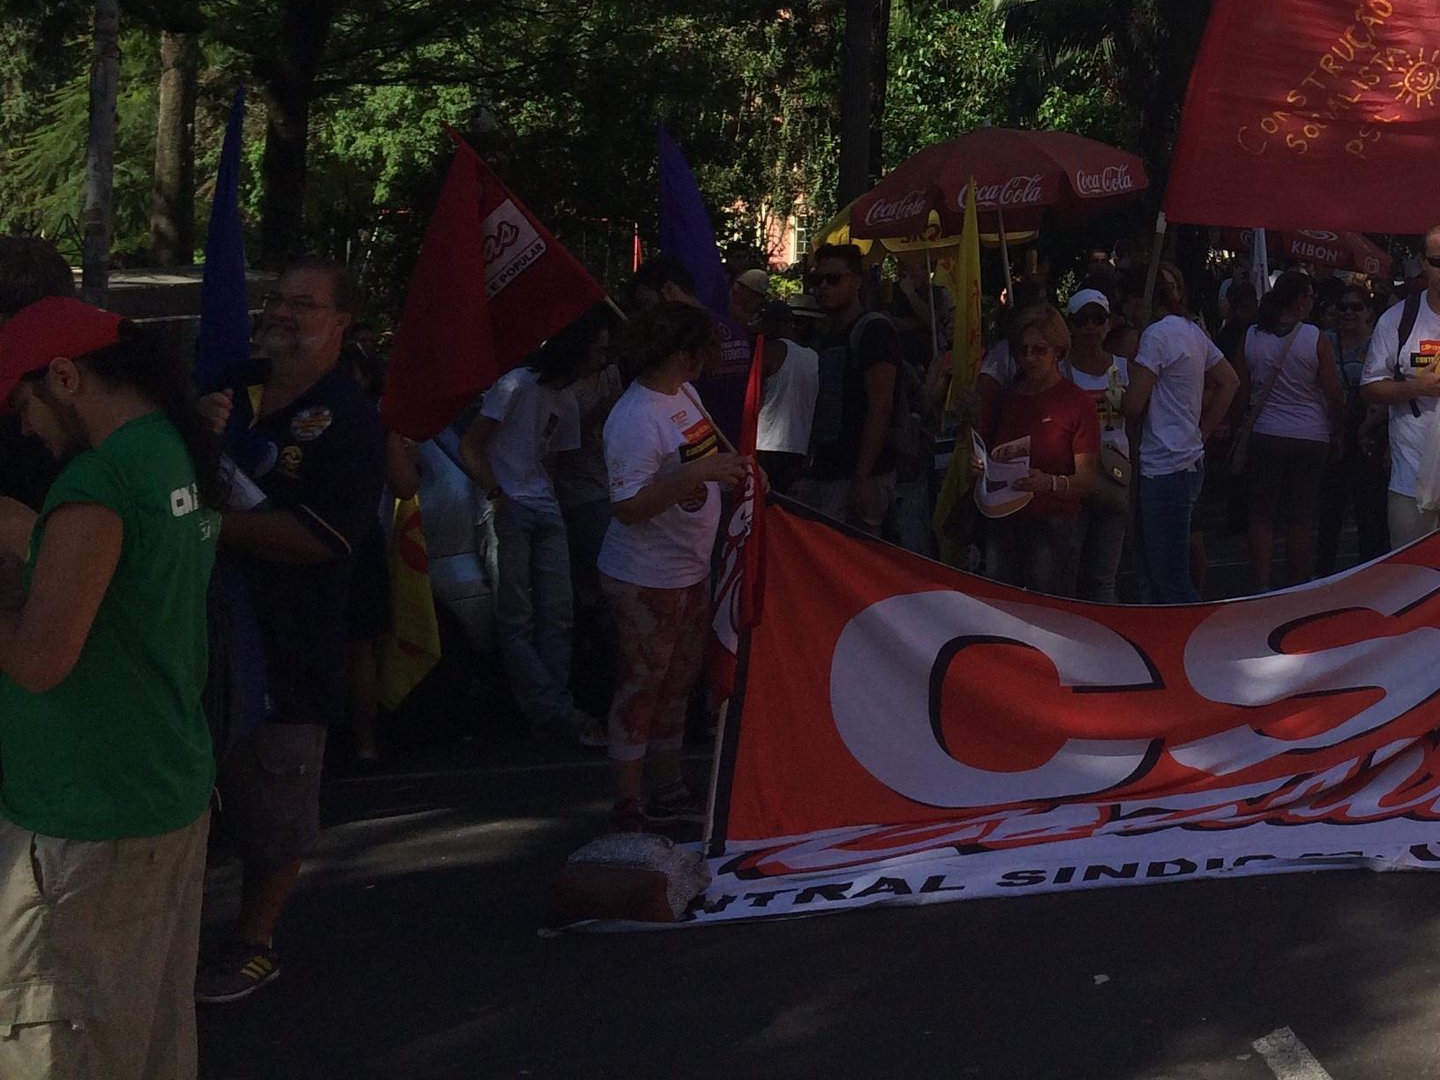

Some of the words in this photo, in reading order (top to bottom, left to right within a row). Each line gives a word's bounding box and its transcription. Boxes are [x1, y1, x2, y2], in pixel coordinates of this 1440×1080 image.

[957, 174, 1045, 209] Cca-Cola
[499, 242, 544, 284] POPULAR
[1291, 239, 1339, 263] KIBON
